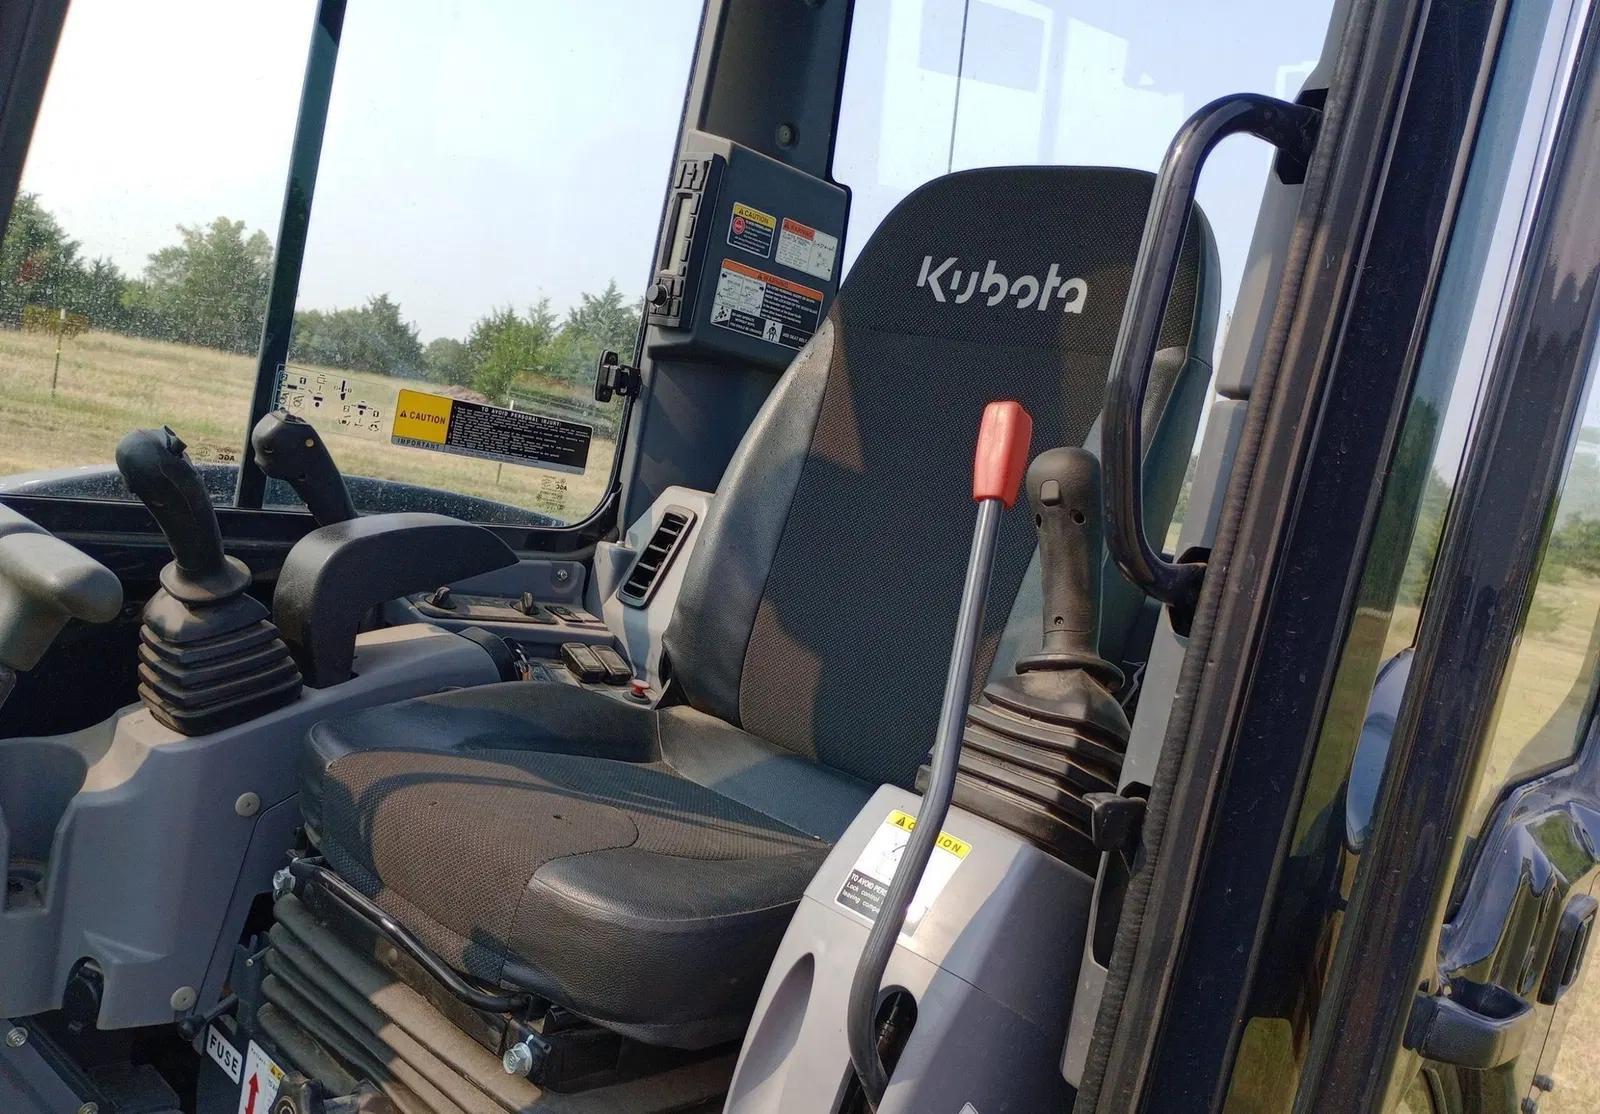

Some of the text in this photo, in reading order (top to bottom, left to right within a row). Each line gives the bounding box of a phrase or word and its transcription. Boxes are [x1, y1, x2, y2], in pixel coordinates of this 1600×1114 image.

[744, 209, 769, 225] CAUTION
[763, 273, 789, 289] WARNING
[916, 256, 1087, 314] Kubota
[409, 411, 446, 425] CAUTION
[491, 408, 508, 416] AVOID
[510, 412, 539, 423] PERSONAL
[397, 437, 440, 450] IMPORTANT
[908, 822, 961, 853] CION
[851, 873, 859, 882] TO
[858, 876, 874, 891] AVOID
[842, 889, 861, 904] leaving
[846, 882, 880, 903] Lock control
[210, 1034, 239, 1076] FUSE
